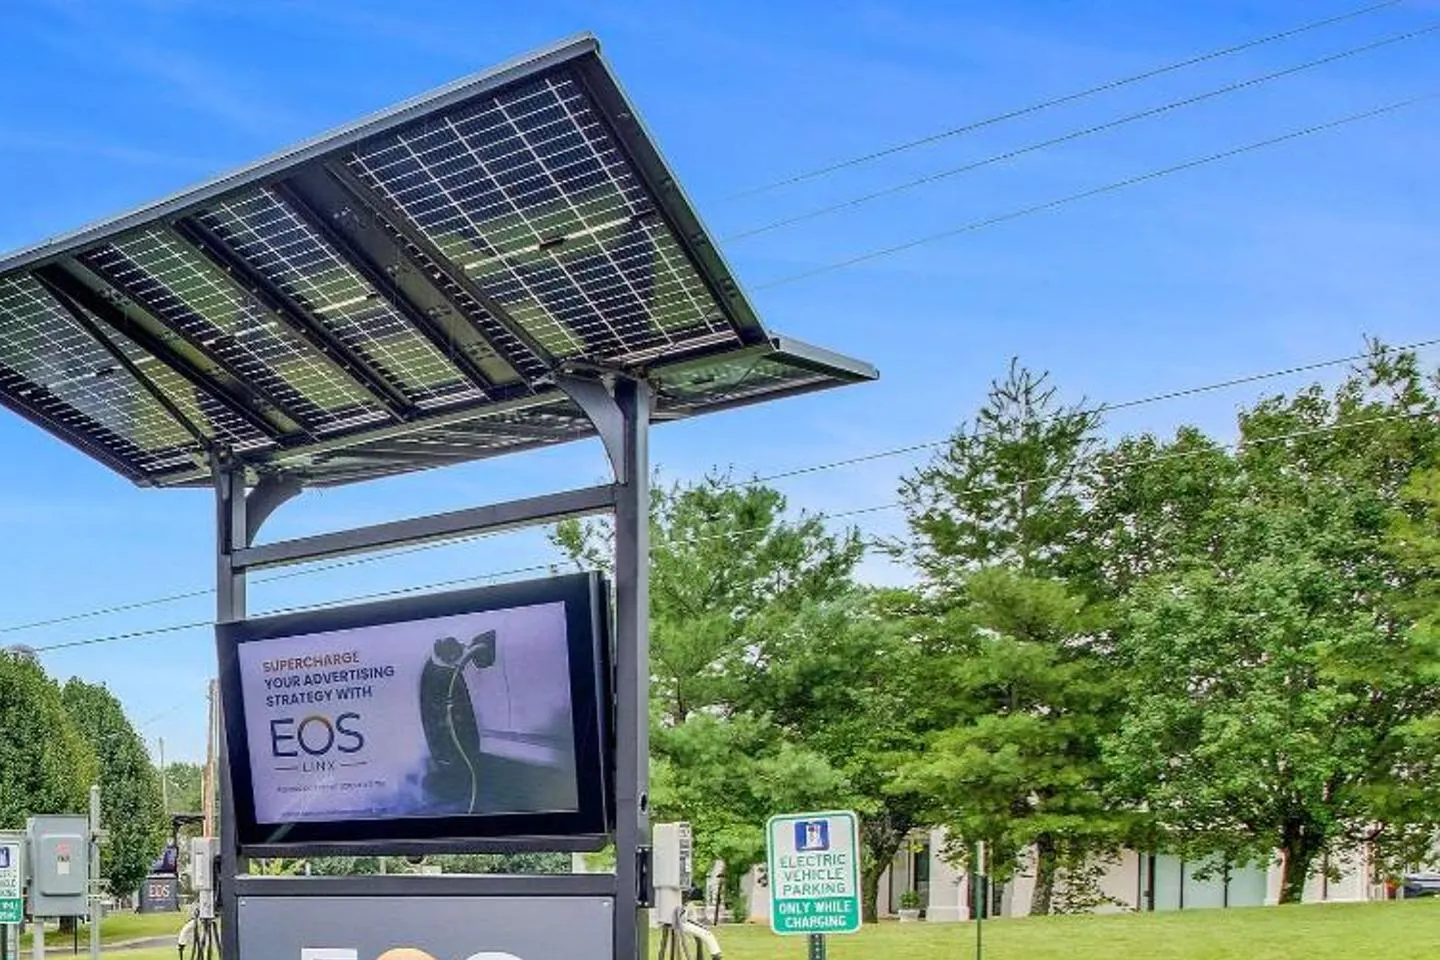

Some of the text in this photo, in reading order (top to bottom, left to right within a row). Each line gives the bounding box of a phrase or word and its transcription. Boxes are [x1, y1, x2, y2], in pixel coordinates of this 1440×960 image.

[262, 651, 360, 673] SUPERCHARGE
[264, 665, 396, 690] YOUR ADVERTISING
[265, 685, 373, 708] STRATEGY WITH
[269, 711, 365, 757] EOS
[302, 760, 335, 773] LINX
[779, 854, 846, 869] ELECTRIC
[783, 867, 845, 882] VEHICLE
[782, 882, 846, 896] PARKING
[778, 899, 853, 915] ONLY WHILE
[783, 914, 847, 929] CHARGING
